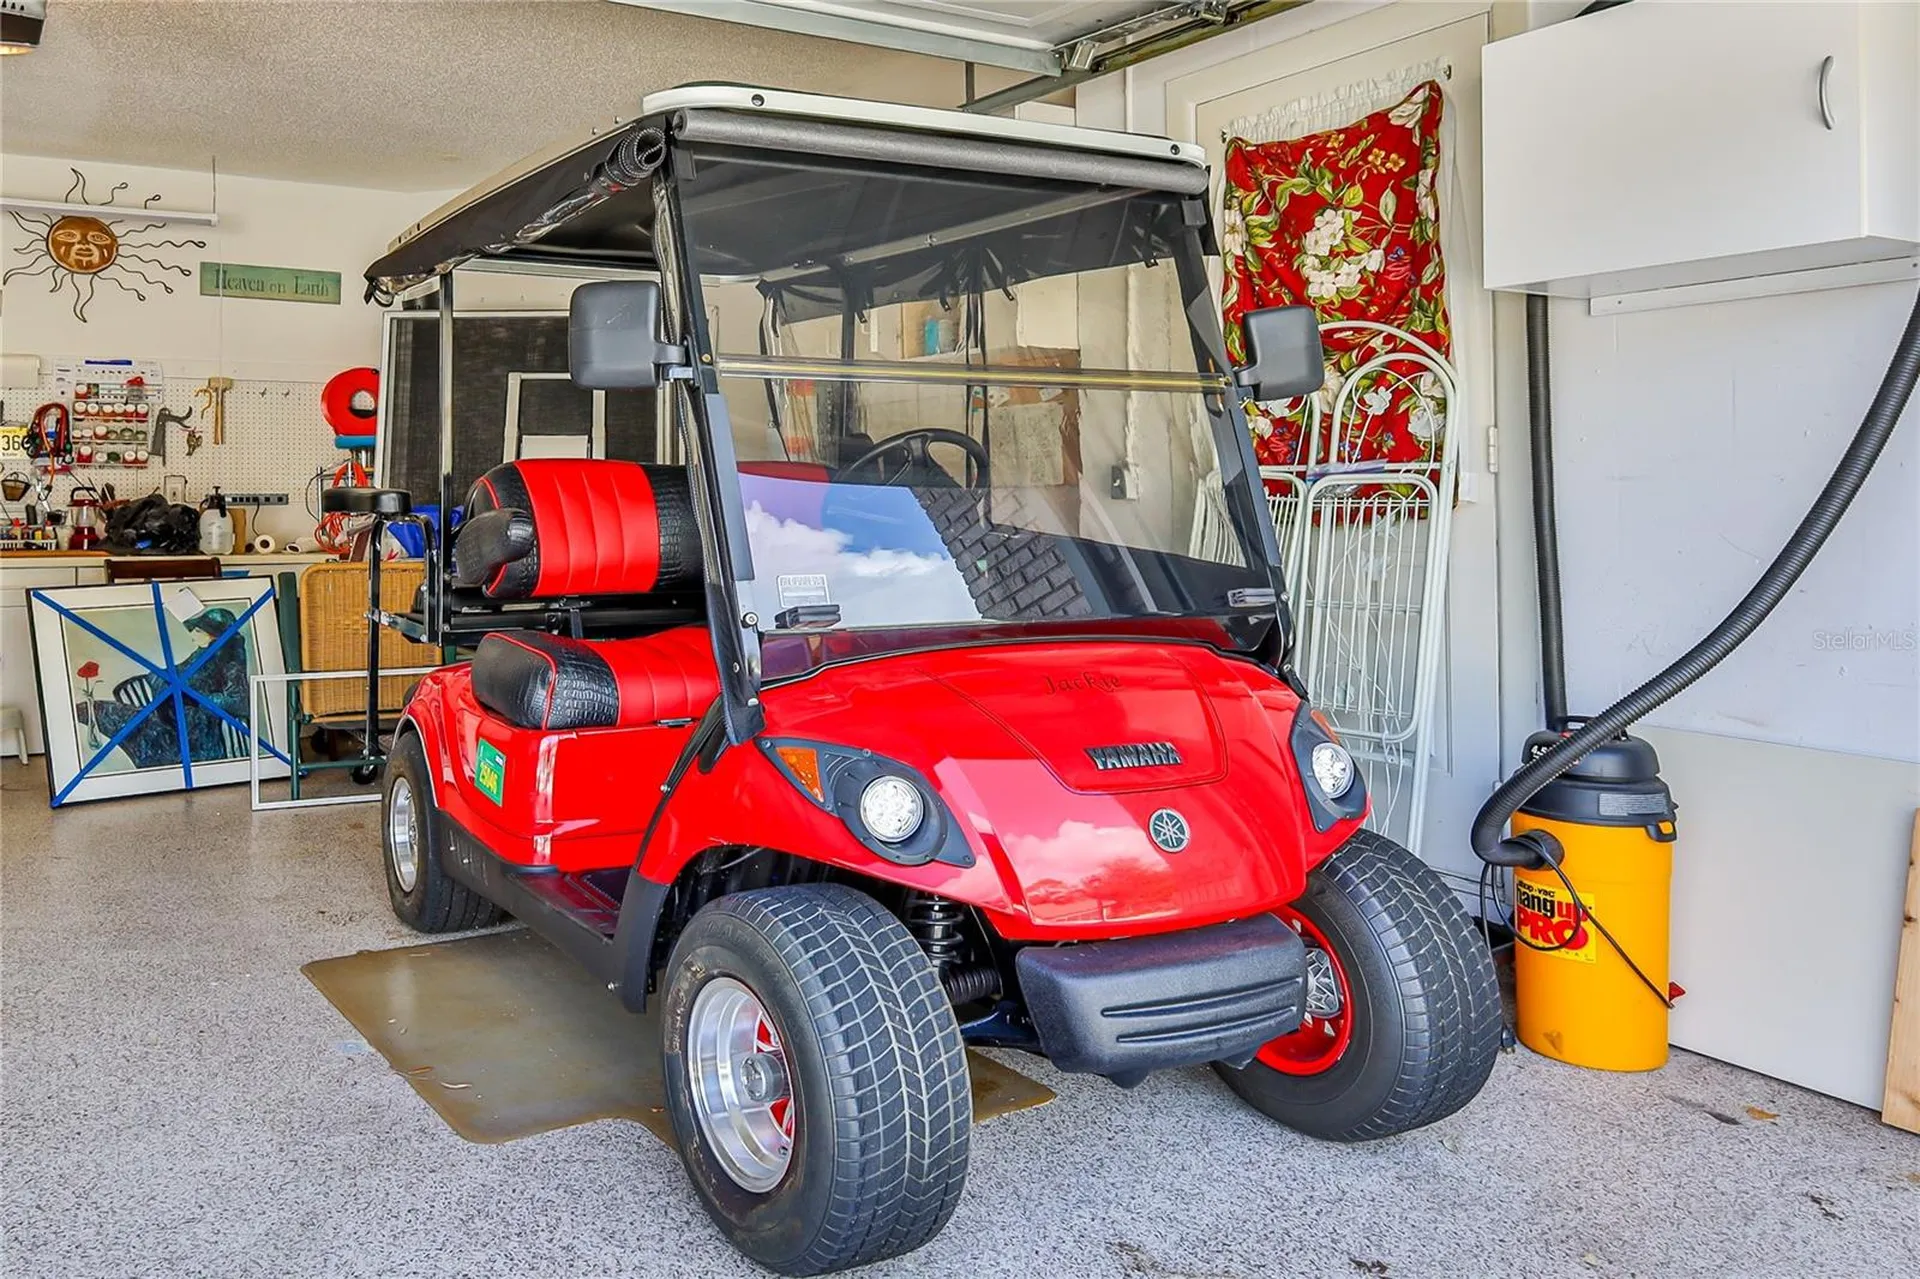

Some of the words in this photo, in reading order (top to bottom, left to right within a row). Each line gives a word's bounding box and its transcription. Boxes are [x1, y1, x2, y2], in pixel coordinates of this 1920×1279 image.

[214, 268, 265, 292] Heaven
[269, 282, 286, 294] on
[293, 275, 329, 297] Earth
[1043, 671, 1124, 695] Jackie
[1084, 741, 1183, 771] YAMAHA
[1516, 905, 1589, 951] PRO
